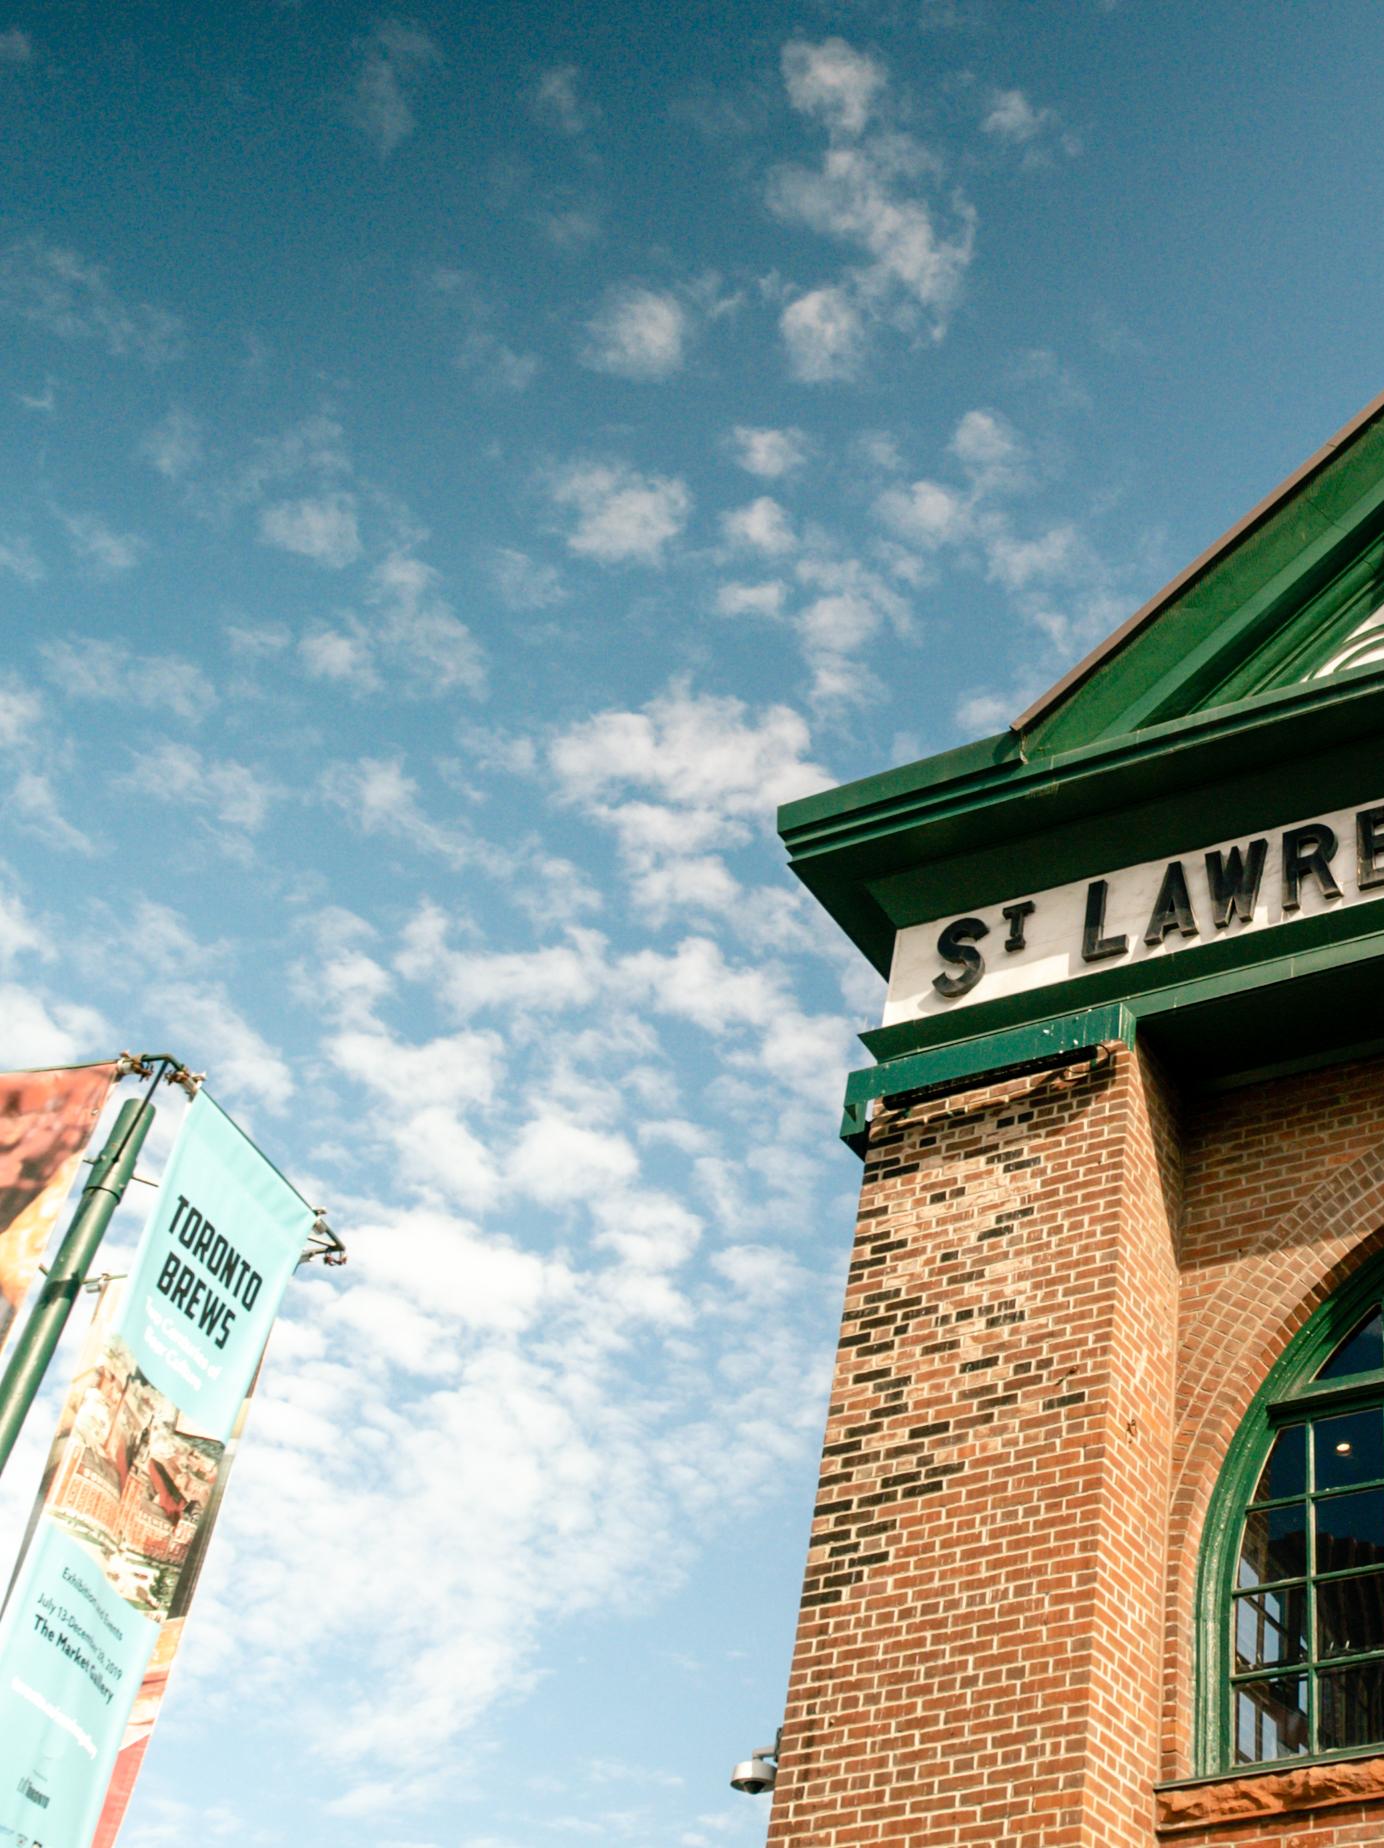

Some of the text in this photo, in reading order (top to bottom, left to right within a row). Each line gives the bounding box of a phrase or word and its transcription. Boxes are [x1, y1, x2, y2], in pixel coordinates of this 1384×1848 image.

[156, 1251, 236, 1350] BREWS
[168, 1194, 263, 1312] TORONTO
[37, 1592, 56, 1615] July
[34, 1613, 114, 1705] The Market Gallery
